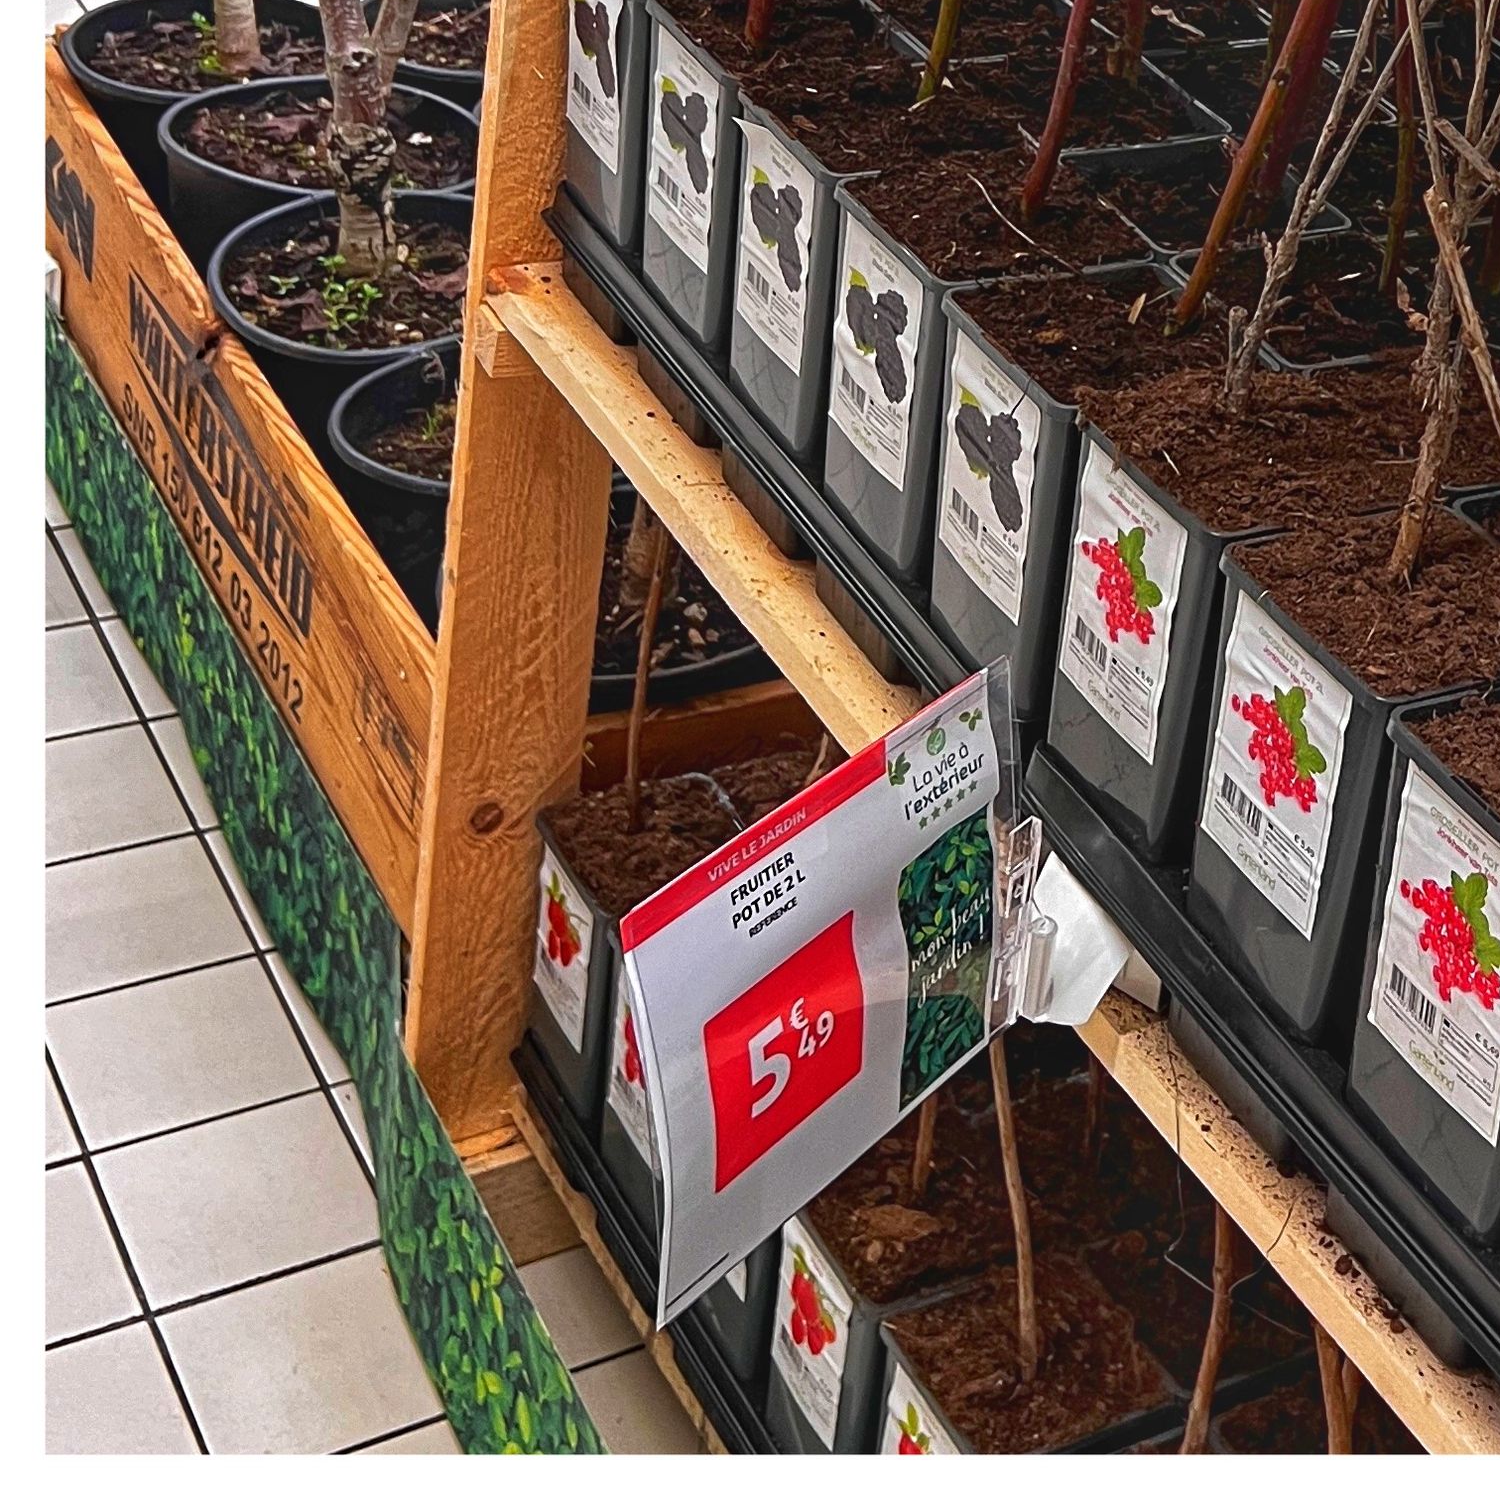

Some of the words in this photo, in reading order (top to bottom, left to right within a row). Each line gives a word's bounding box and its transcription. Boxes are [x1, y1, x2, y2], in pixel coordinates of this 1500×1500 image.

[123, 383, 156, 465] SNR
[193, 505, 223, 584] 612
[230, 570, 252, 631] 03
[257, 620, 304, 725] 2012
[904, 753, 984, 820] l'extérieur
[913, 771, 933, 793] La
[934, 753, 956, 776] vie
[707, 851, 740, 882] VIVE
[741, 840, 758, 860] LE
[759, 806, 807, 849] JARDIN
[730, 852, 794, 906] FRUITIER
[732, 897, 761, 929] POT
[763, 882, 783, 907] DE
[784, 875, 795, 892] 2
[796, 869, 806, 884] L
[748, 896, 798, 938] REFERENCE
[912, 935, 946, 972] mon
[918, 938, 972, 1009] jardin
[747, 1016, 792, 1120] 5
[796, 1010, 835, 1059] 49
